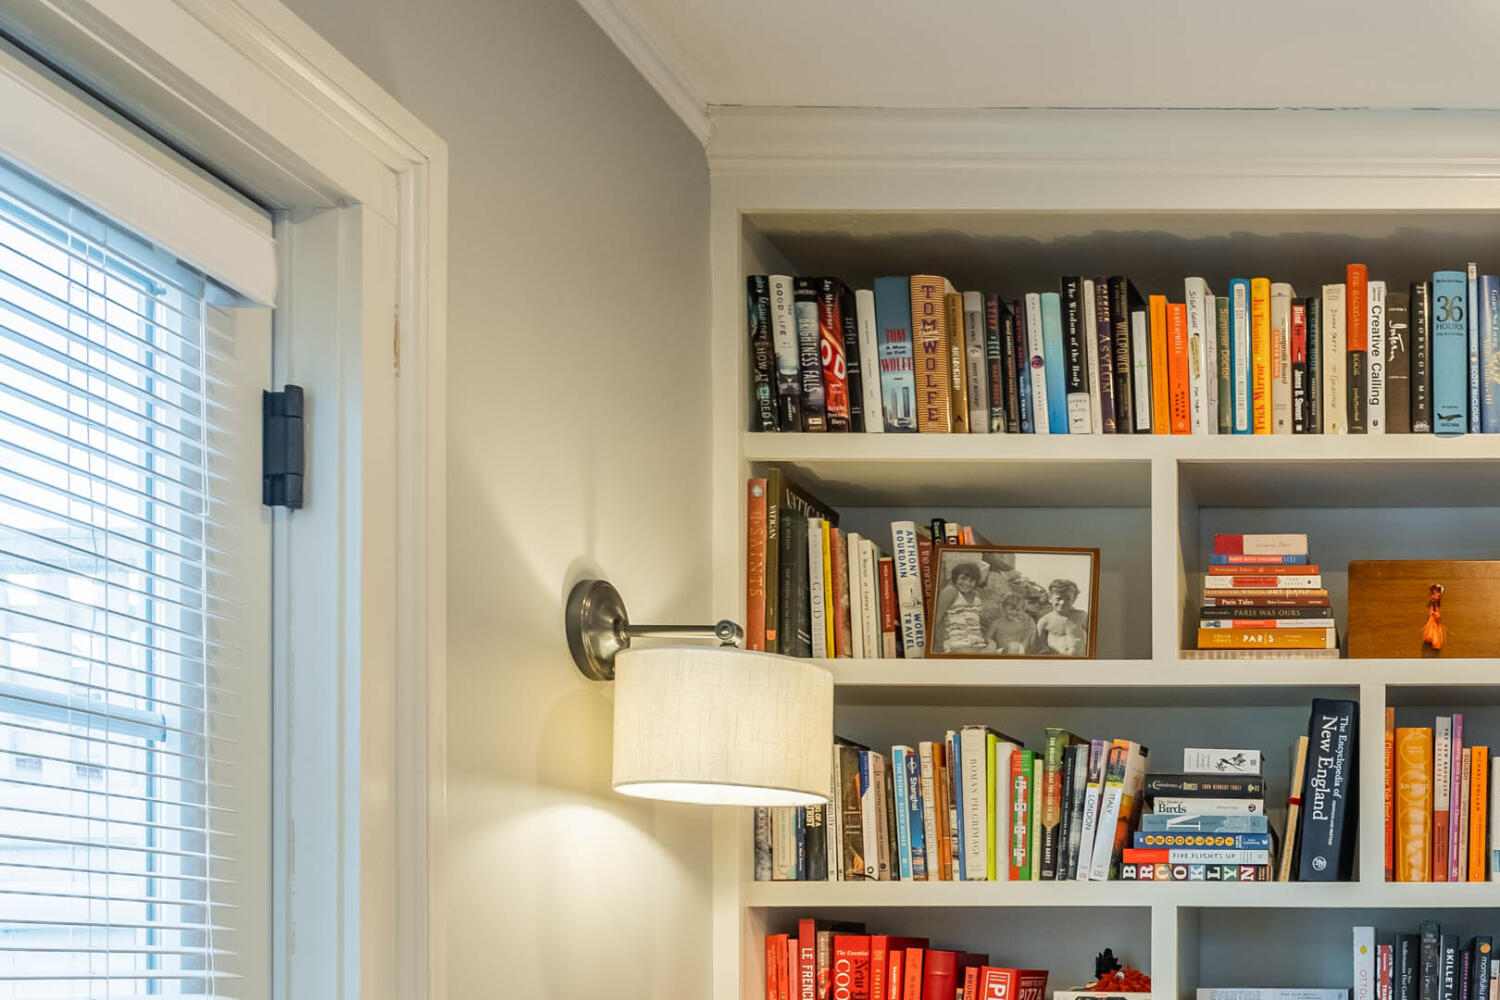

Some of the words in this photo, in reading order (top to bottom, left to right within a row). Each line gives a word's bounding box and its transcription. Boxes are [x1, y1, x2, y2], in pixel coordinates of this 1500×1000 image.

[776, 283, 785, 311] GOOD
[1068, 282, 1076, 299] The
[1253, 297, 1264, 310] Jia
[920, 285, 936, 331] TOM
[1068, 302, 1077, 334] Wisdom
[1294, 307, 1303, 323] Blind
[1436, 296, 1464, 322] 36
[778, 315, 786, 336] LIFE
[886, 328, 905, 343] TOM
[1071, 337, 1078, 346] of
[1220, 308, 1229, 346] Summer
[1253, 314, 1264, 354] Tolentino
[1371, 305, 1382, 357] Creative
[1388, 320, 1408, 361] Intern
[1436, 323, 1463, 331] HOURS
[799, 319, 819, 367] BRIGHTNESS
[1071, 349, 1079, 361] the
[1116, 322, 1128, 373] WILLPOWER
[880, 357, 913, 372] WOLFE
[1071, 366, 1081, 387] Body
[1099, 334, 1111, 393] ASYLUM
[1221, 350, 1229, 380] Doctor
[803, 370, 820, 392] FALLS
[922, 340, 938, 423] WOLFE
[1254, 363, 1266, 400] Mirror
[1369, 363, 1382, 405] Calling
[1255, 404, 1266, 433] Trick
[749, 527, 762, 597] SAINTS
[896, 530, 907, 578] BOURDAIN
[906, 530, 918, 577] ANTHONY
[904, 613, 914, 649] TRAVEL
[913, 613, 924, 648] WORLD
[1320, 715, 1338, 752] New
[1339, 716, 1348, 732] The
[1334, 735, 1347, 786] Encyclopedia
[910, 777, 919, 811] Shanghai
[1106, 793, 1115, 814] ITALY
[1311, 756, 1333, 820] England
[1333, 788, 1342, 798] of
[1085, 794, 1095, 830] LONDON
[1159, 804, 1187, 813] Birds
[801, 947, 814, 959] LE
[1445, 949, 1454, 989] SKILLET
[854, 959, 868, 989] New
